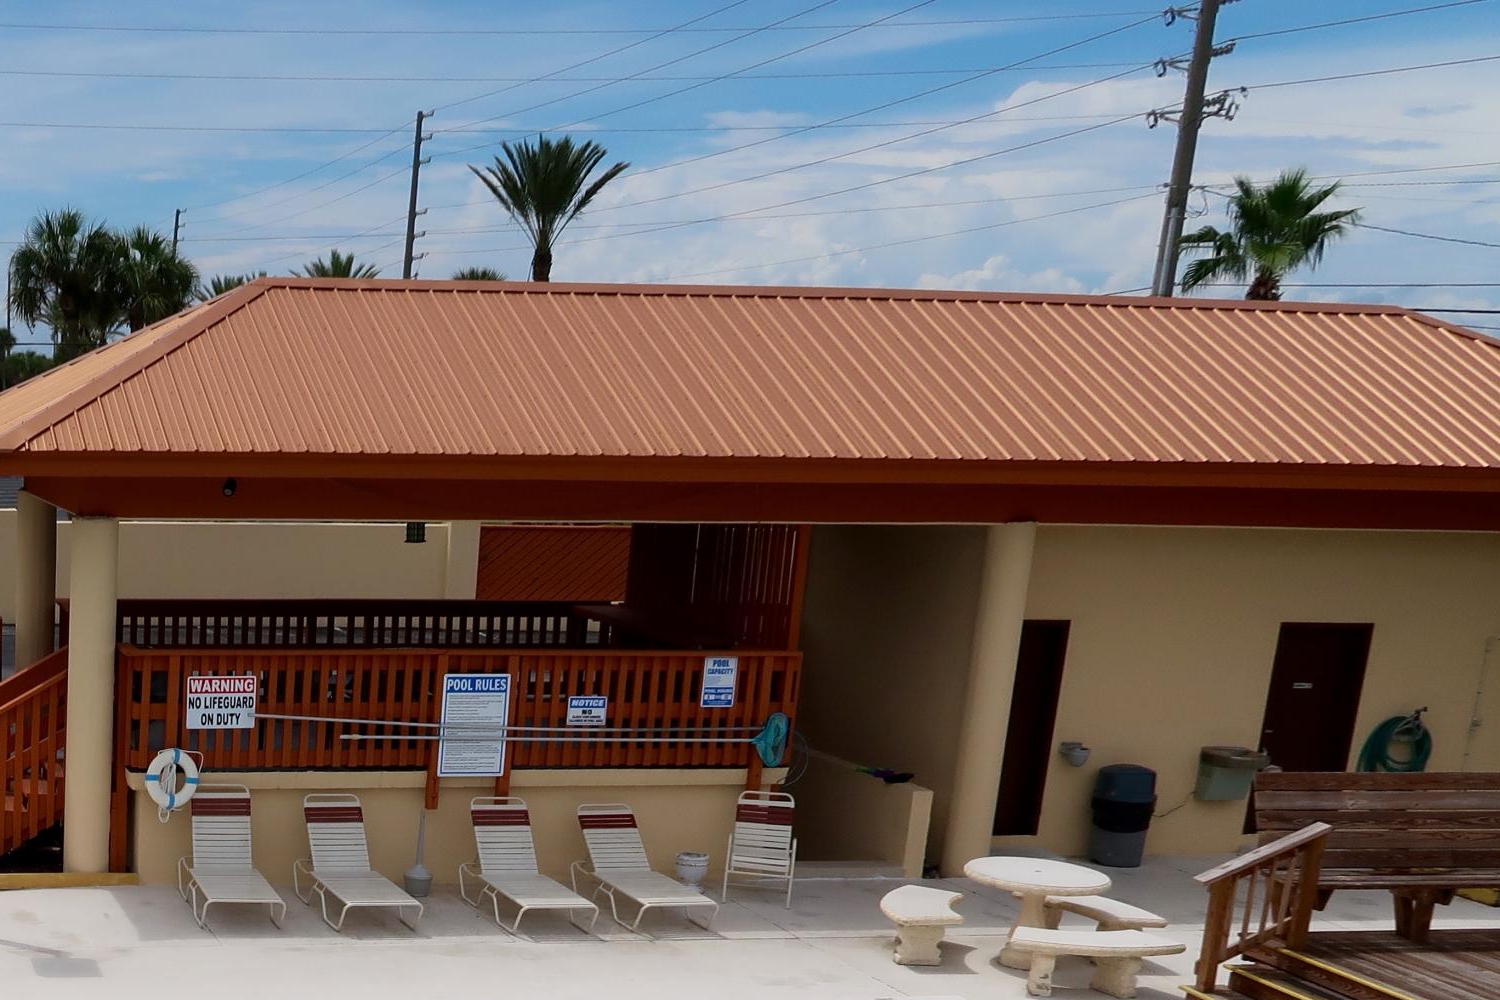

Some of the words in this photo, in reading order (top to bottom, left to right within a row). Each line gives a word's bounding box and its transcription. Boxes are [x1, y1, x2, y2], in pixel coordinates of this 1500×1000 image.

[190, 679, 254, 693] WARNING
[447, 679, 473, 691] POOL
[475, 679, 507, 691] RULES
[189, 696, 202, 709] NO
[204, 696, 254, 709] LIFEGUARD
[200, 713, 214, 726] ON
[216, 713, 240, 726] DUTY
